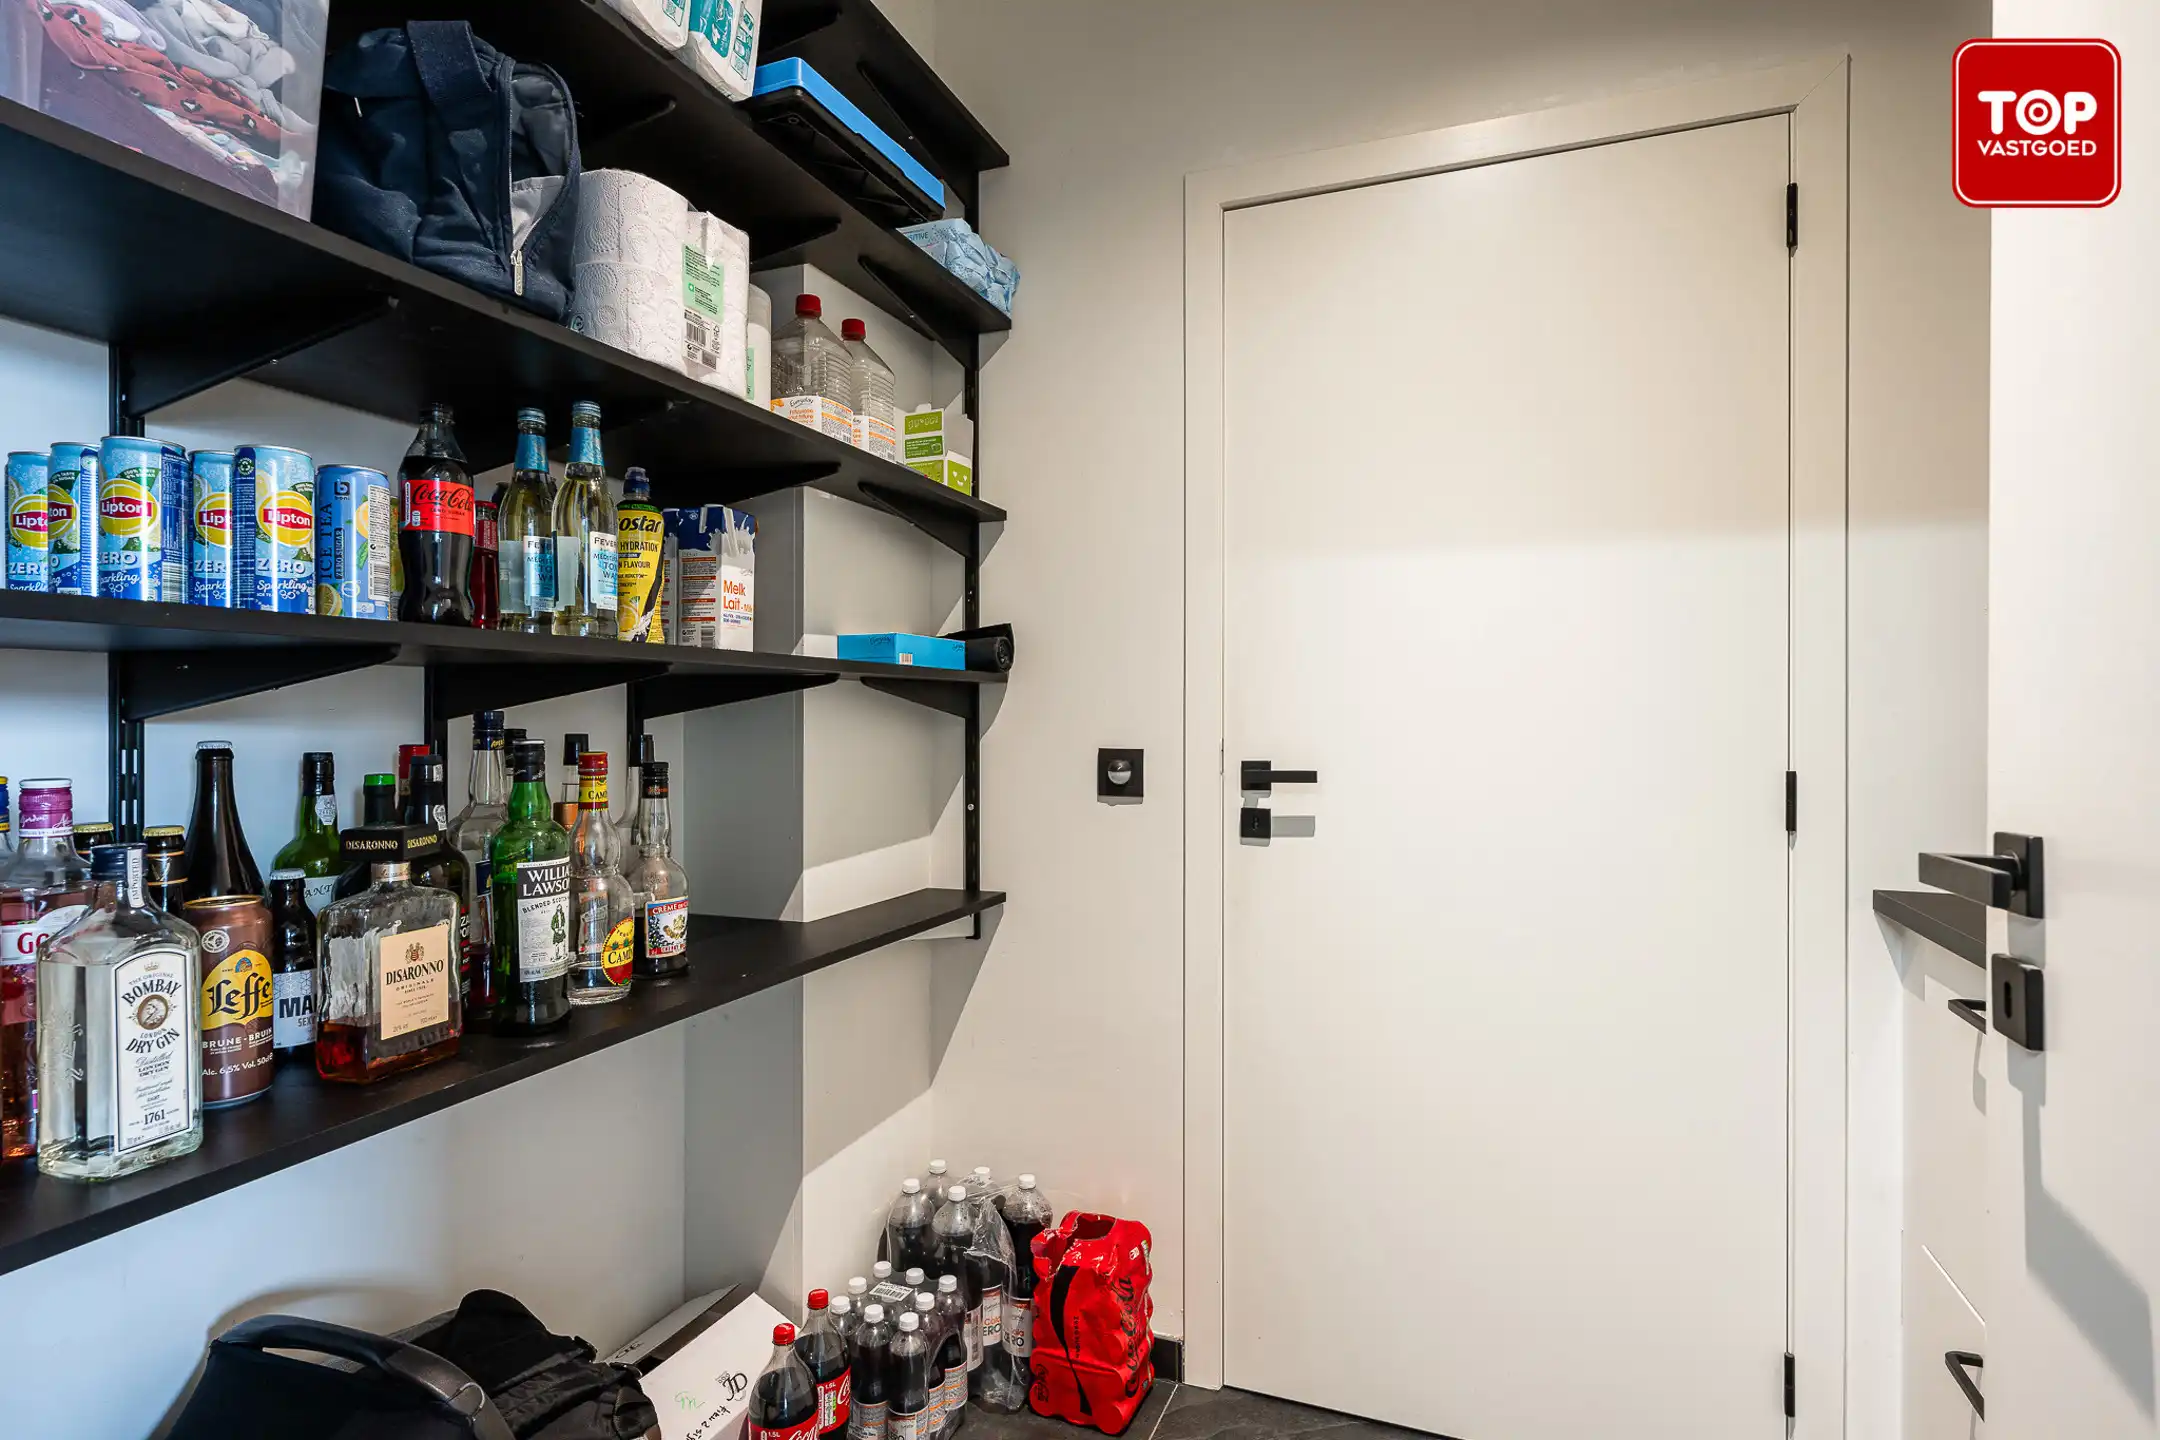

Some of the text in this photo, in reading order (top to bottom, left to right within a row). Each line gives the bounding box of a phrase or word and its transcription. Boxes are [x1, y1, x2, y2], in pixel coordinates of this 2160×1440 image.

[101, 501, 145, 516] Lipton
[267, 510, 311, 526] Lipton
[319, 502, 332, 579] ICE TEA
[620, 540, 659, 553] HYDRATION
[99, 551, 137, 565] ERO
[623, 560, 651, 570] FLAVOUR
[256, 559, 306, 574] ZERO
[256, 578, 307, 593] Sparkling
[723, 580, 746, 597] Melk
[723, 596, 740, 611] Lait
[345, 839, 399, 851] DISARONNO
[406, 833, 438, 849] DISARONNO
[132, 857, 140, 901] IMPORTED
[521, 900, 551, 914] BLENDED
[385, 959, 444, 986] DISARONNO
[121, 978, 182, 1007] BOMBAY
[395, 978, 435, 992] ORIGINALE
[207, 971, 273, 1021] Leffe
[125, 1027, 180, 1054] DRY GIN
[140, 1027, 168, 1039] LONDON
[202, 1036, 242, 1049] BRUNE
[201, 1068, 218, 1076] Alc.
[219, 1063, 241, 1075] 6,5%
[241, 1060, 256, 1070] Vol.
[143, 1109, 166, 1125] 1761
